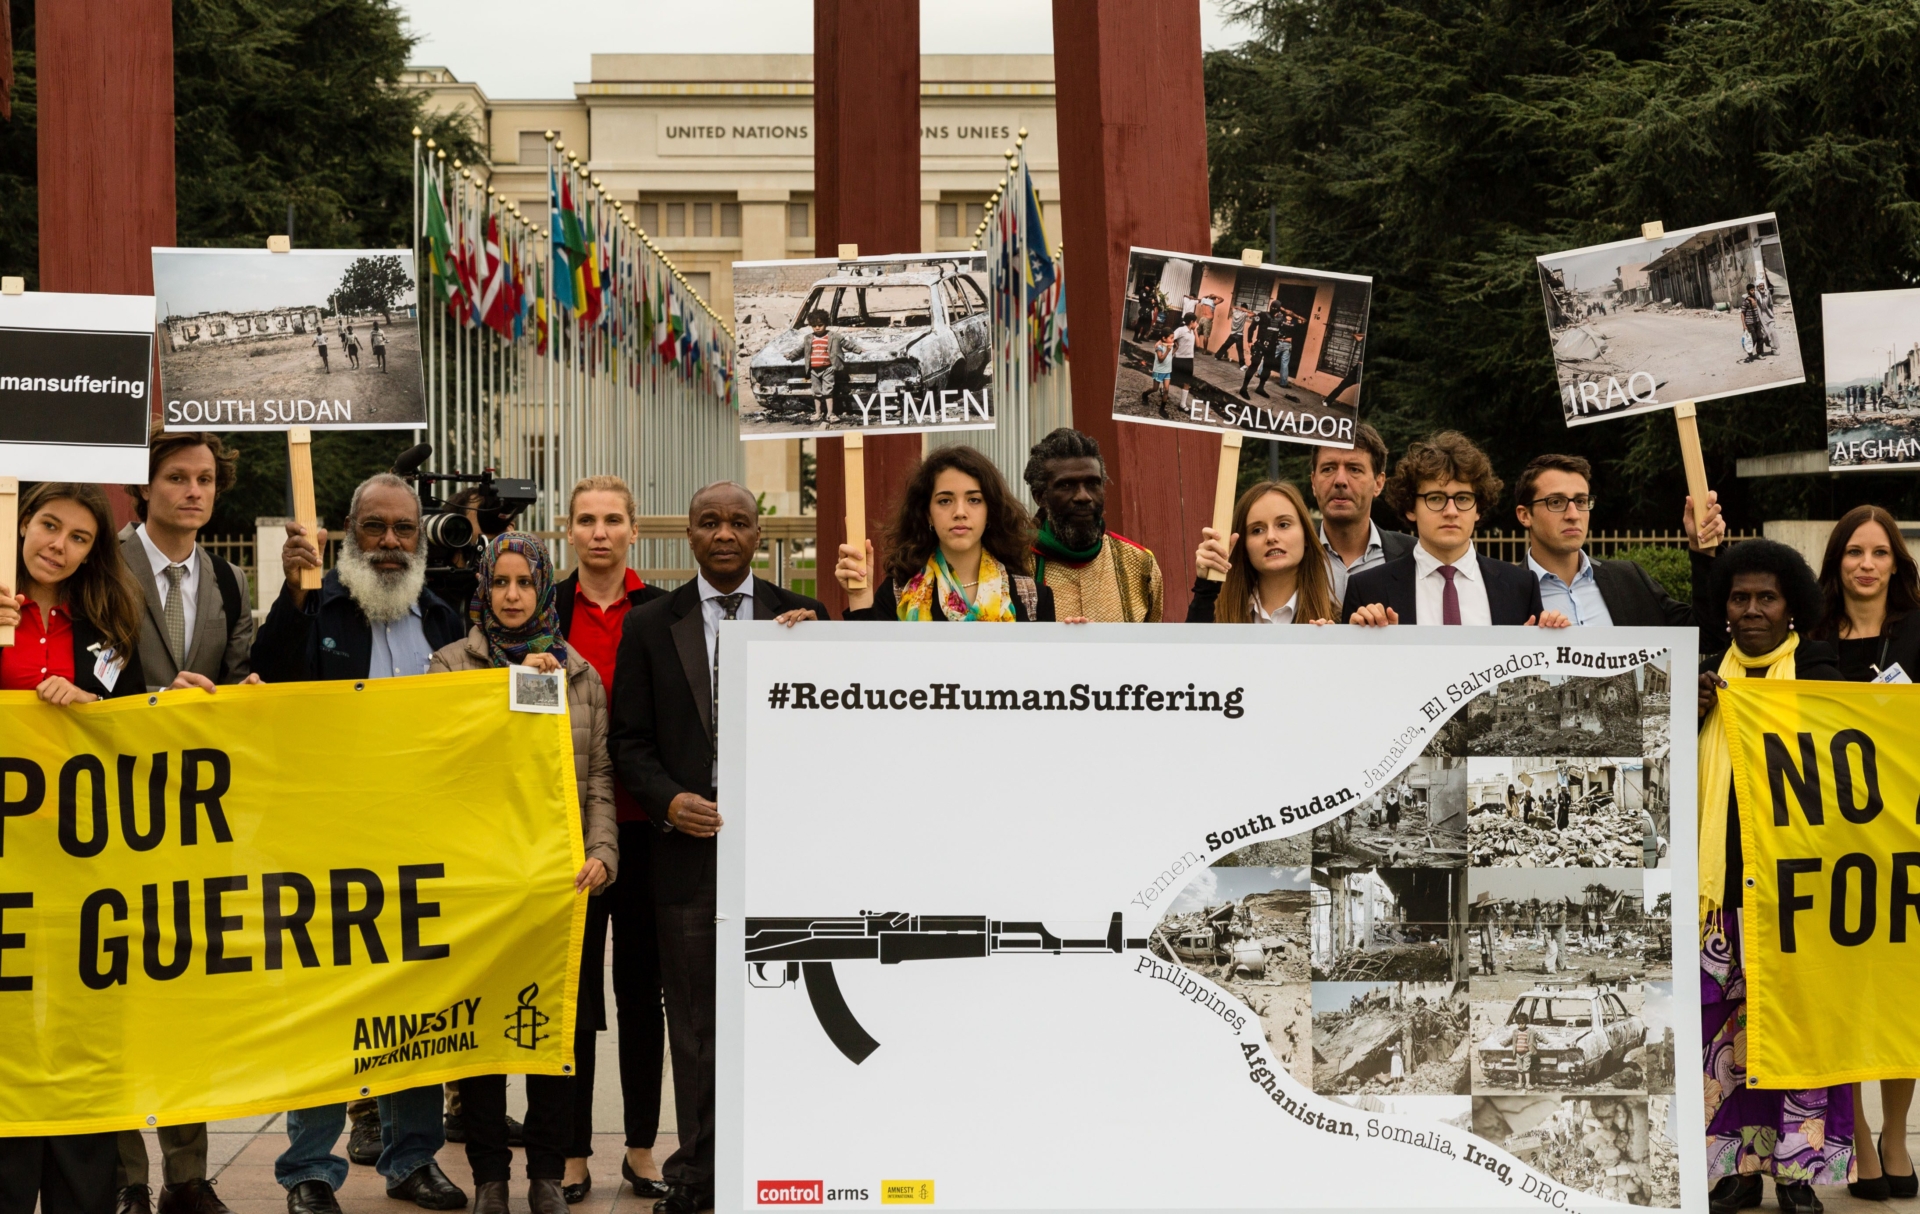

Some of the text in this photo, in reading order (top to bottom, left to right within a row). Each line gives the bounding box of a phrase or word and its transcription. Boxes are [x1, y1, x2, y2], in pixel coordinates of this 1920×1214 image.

[666, 126, 808, 139] UNITED NATIONS
[957, 126, 1010, 139] UNIES
[0, 375, 145, 399] mansuffering
[852, 388, 989, 426] YEMEN
[1568, 371, 1659, 415] IRAQ
[168, 400, 352, 423] SOUTH SUDAN
[1190, 399, 1353, 440] EL SALVADOR
[768, 682, 1245, 719] #ReduceHumanSuffering
[1130, 851, 1206, 912] Yemen,
[1205, 814, 1277, 853] South
[1279, 787, 1361, 826] Sudan,
[1362, 723, 1426, 789] Jamaica,
[1419, 696, 1448, 724] El
[1446, 650, 1550, 705] Salvador,
[1763, 728, 1884, 827] NO
[0, 748, 234, 859] POUR
[78, 863, 450, 991] GUERRE
[353, 996, 482, 1051] AMNESTY
[354, 1031, 479, 1075] INTERNATIONAL
[1134, 955, 1247, 1036] Philippines,
[1240, 1041, 1360, 1141] Afghanistan,
[1366, 1118, 1457, 1161] Somalia,
[1463, 1144, 1513, 1186] Iraq,
[759, 1184, 869, 1201] control arms
[887, 1186, 915, 1194] AMNESTY
